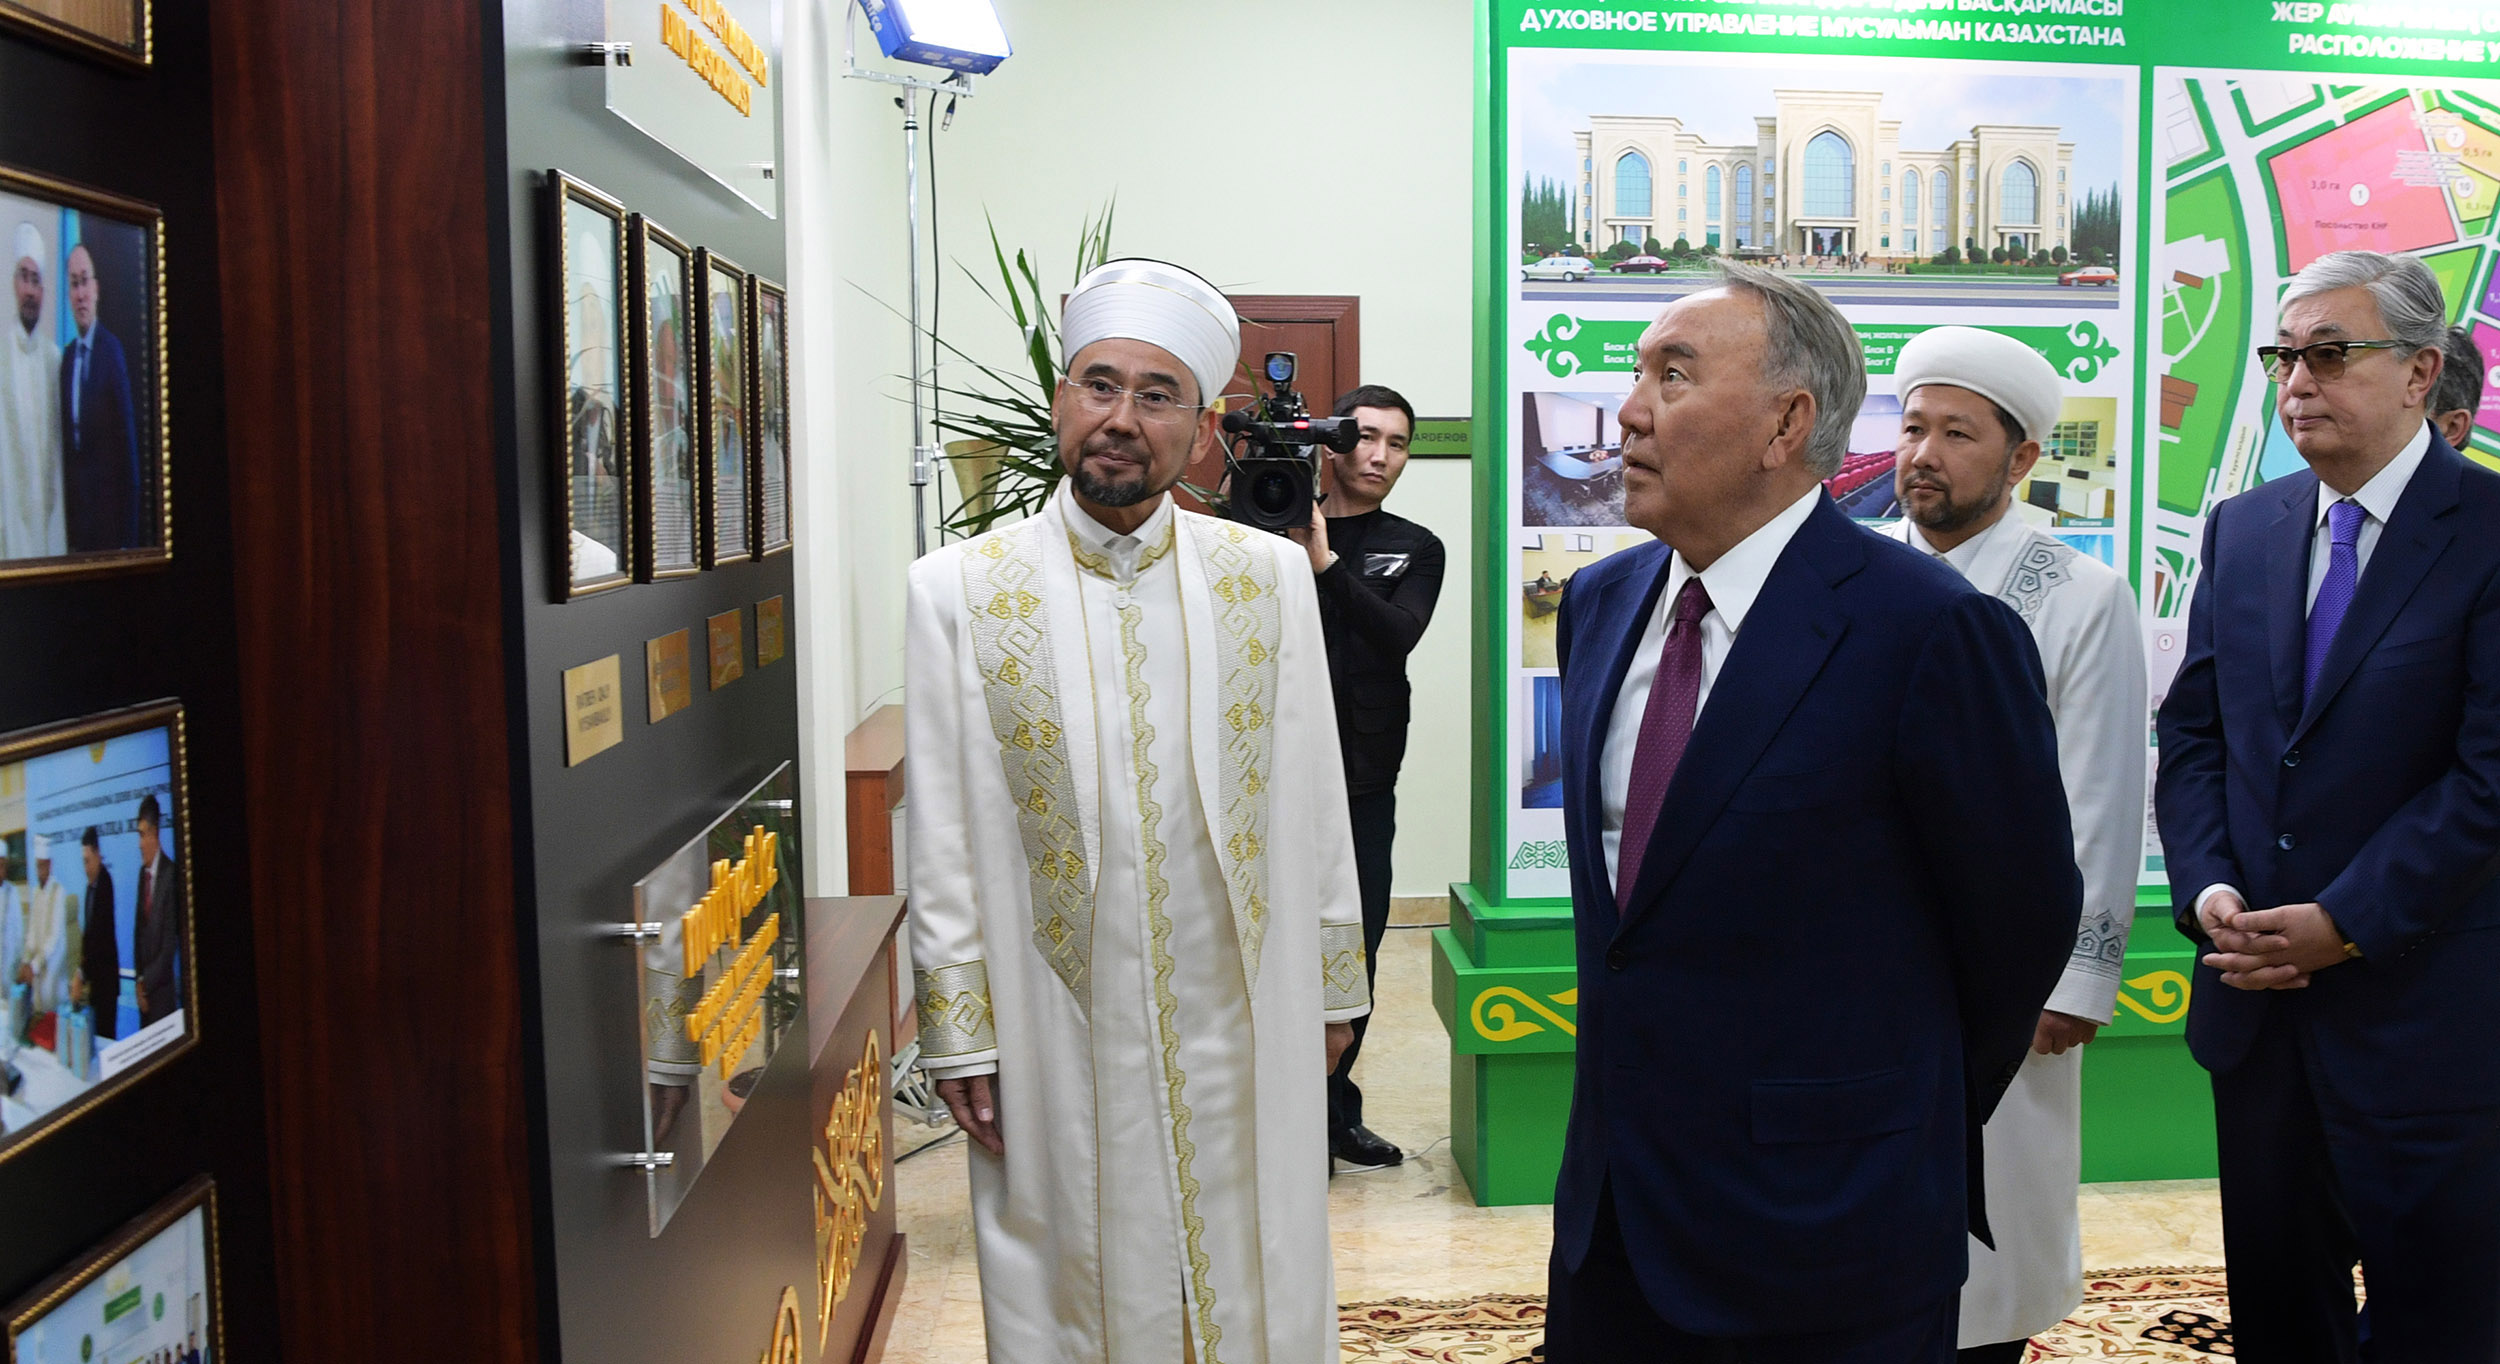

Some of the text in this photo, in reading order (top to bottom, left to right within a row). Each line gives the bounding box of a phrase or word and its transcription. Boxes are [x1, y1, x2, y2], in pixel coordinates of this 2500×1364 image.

[2271, 1, 2324, 23] ЖЕР
[1520, 9, 2126, 46] ДУХОВНОЕ УПРАВЛЕНИЕ МУСУЛЬМАН КАЗАХСТАНА
[2289, 33, 2484, 62] РАСПОЛОЖЕНИЕ
[1413, 432, 1468, 442] ARDEROB
